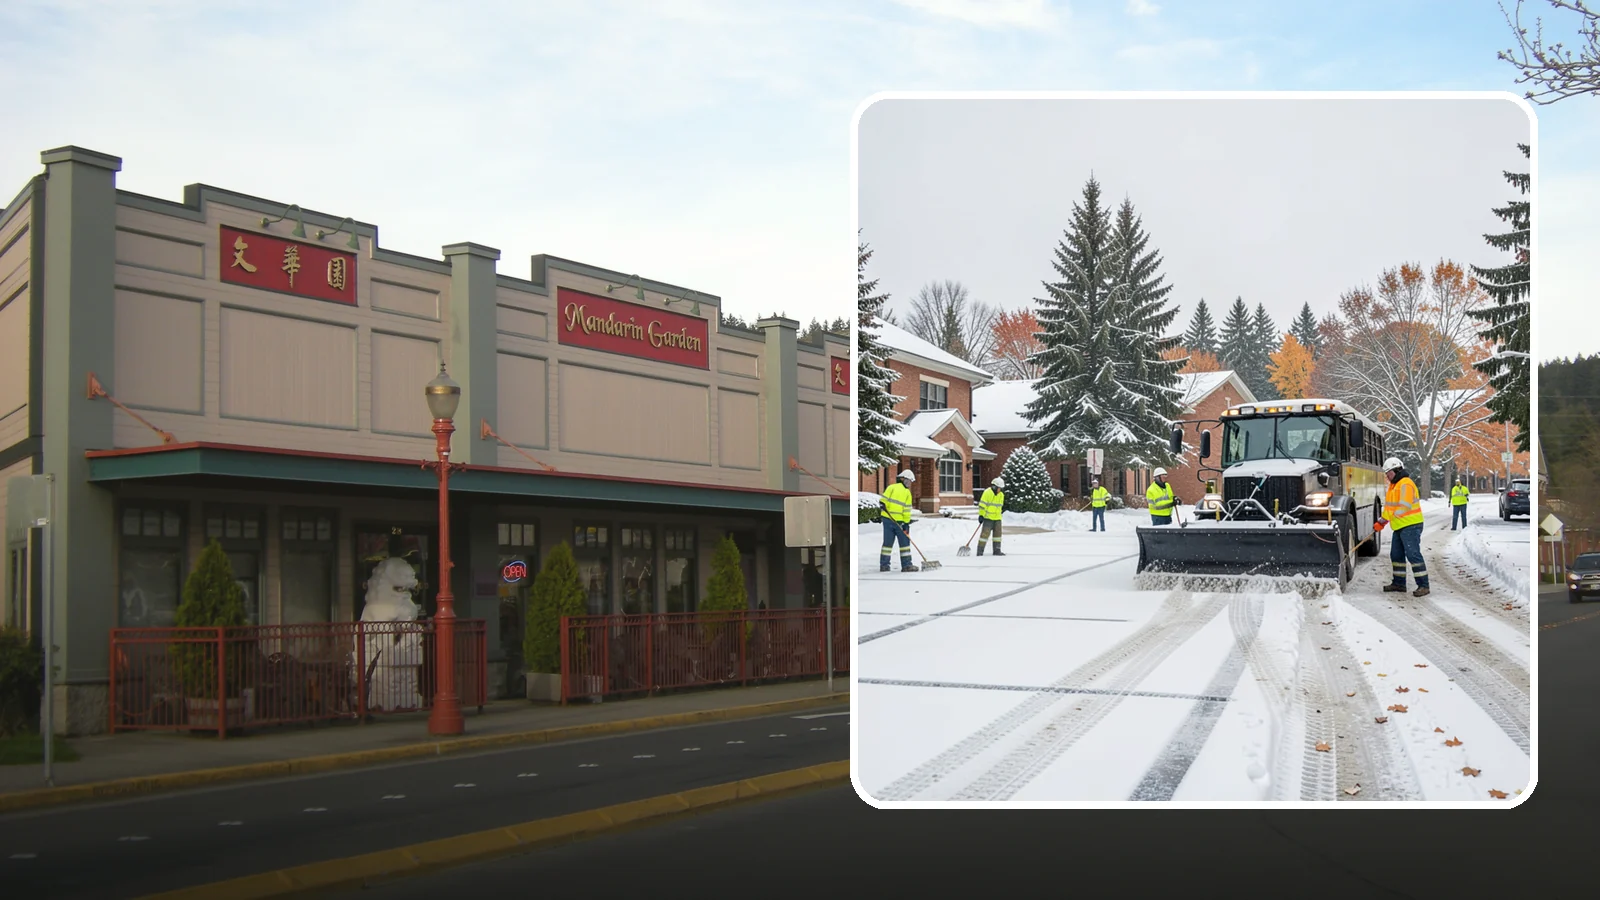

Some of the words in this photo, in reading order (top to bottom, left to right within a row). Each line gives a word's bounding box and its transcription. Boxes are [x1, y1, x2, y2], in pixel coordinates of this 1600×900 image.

[231, 235, 346, 291] 文華園
[565, 302, 644, 341] Mandarin
[648, 320, 702, 353] Garden
[503, 565, 527, 578] OPEN
